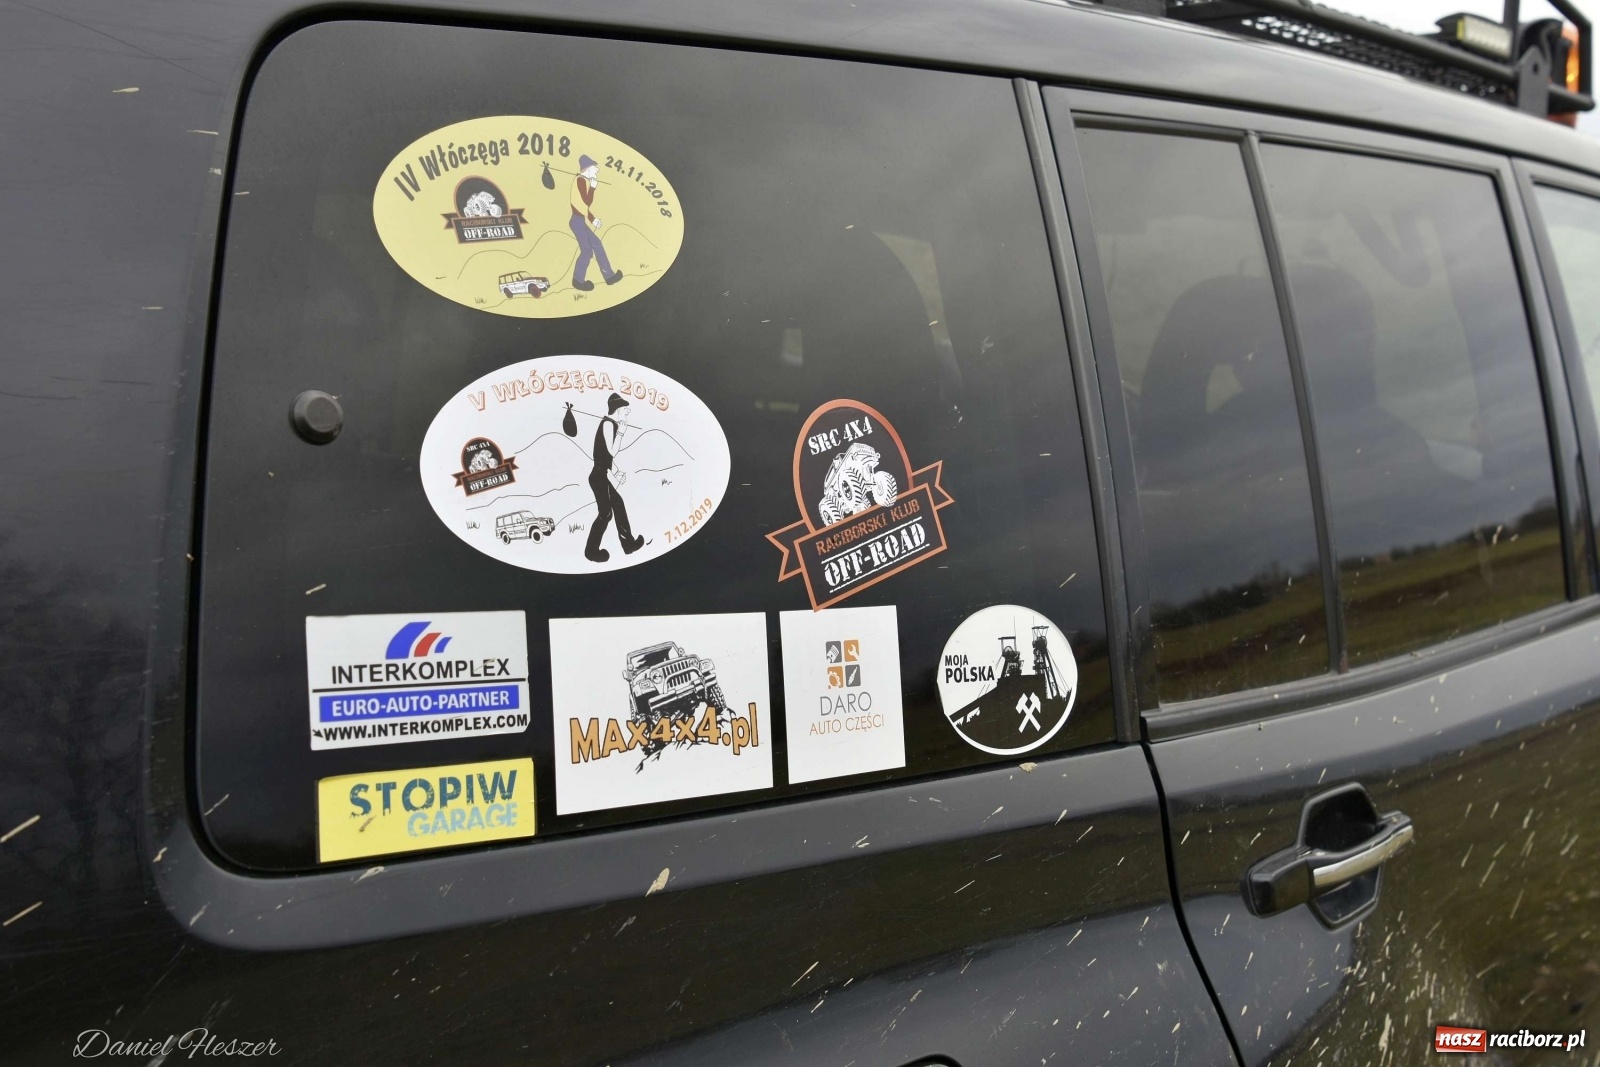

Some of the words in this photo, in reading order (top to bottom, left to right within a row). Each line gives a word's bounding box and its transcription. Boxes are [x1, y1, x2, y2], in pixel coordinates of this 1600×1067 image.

[393, 163, 421, 202] IV
[418, 138, 510, 181] Włóczęga
[516, 133, 571, 157] 2018
[604, 155, 672, 218] 24.11.2018
[464, 226, 515, 239] OFF-ROAD
[467, 391, 486, 411] V
[491, 369, 614, 403] WŁÓCZĘGA
[620, 376, 670, 412] 2019
[466, 444, 478, 452] SRC
[808, 428, 842, 456] SRC
[843, 416, 873, 442] 4X4
[470, 473, 509, 491] OFF-ROAD
[664, 497, 714, 544] 7.12.2019
[815, 512, 888, 556] RACIBORSKI
[890, 498, 920, 522] KLUB
[824, 522, 926, 587] OFF-ROAD
[332, 658, 510, 684] INTERKOMPLEX
[944, 654, 969, 669] MOJA
[945, 665, 995, 684] POLSKA
[332, 690, 510, 717] EURO-AUTO-PARTNER
[819, 691, 872, 716] DARO
[323, 714, 528, 741] WWW.INTERKOMPLEX.COM
[809, 721, 842, 736] AUTO
[845, 712, 885, 733] CZĘŚCI
[349, 770, 517, 818] STOPIW
[407, 802, 518, 838] GARAGE
